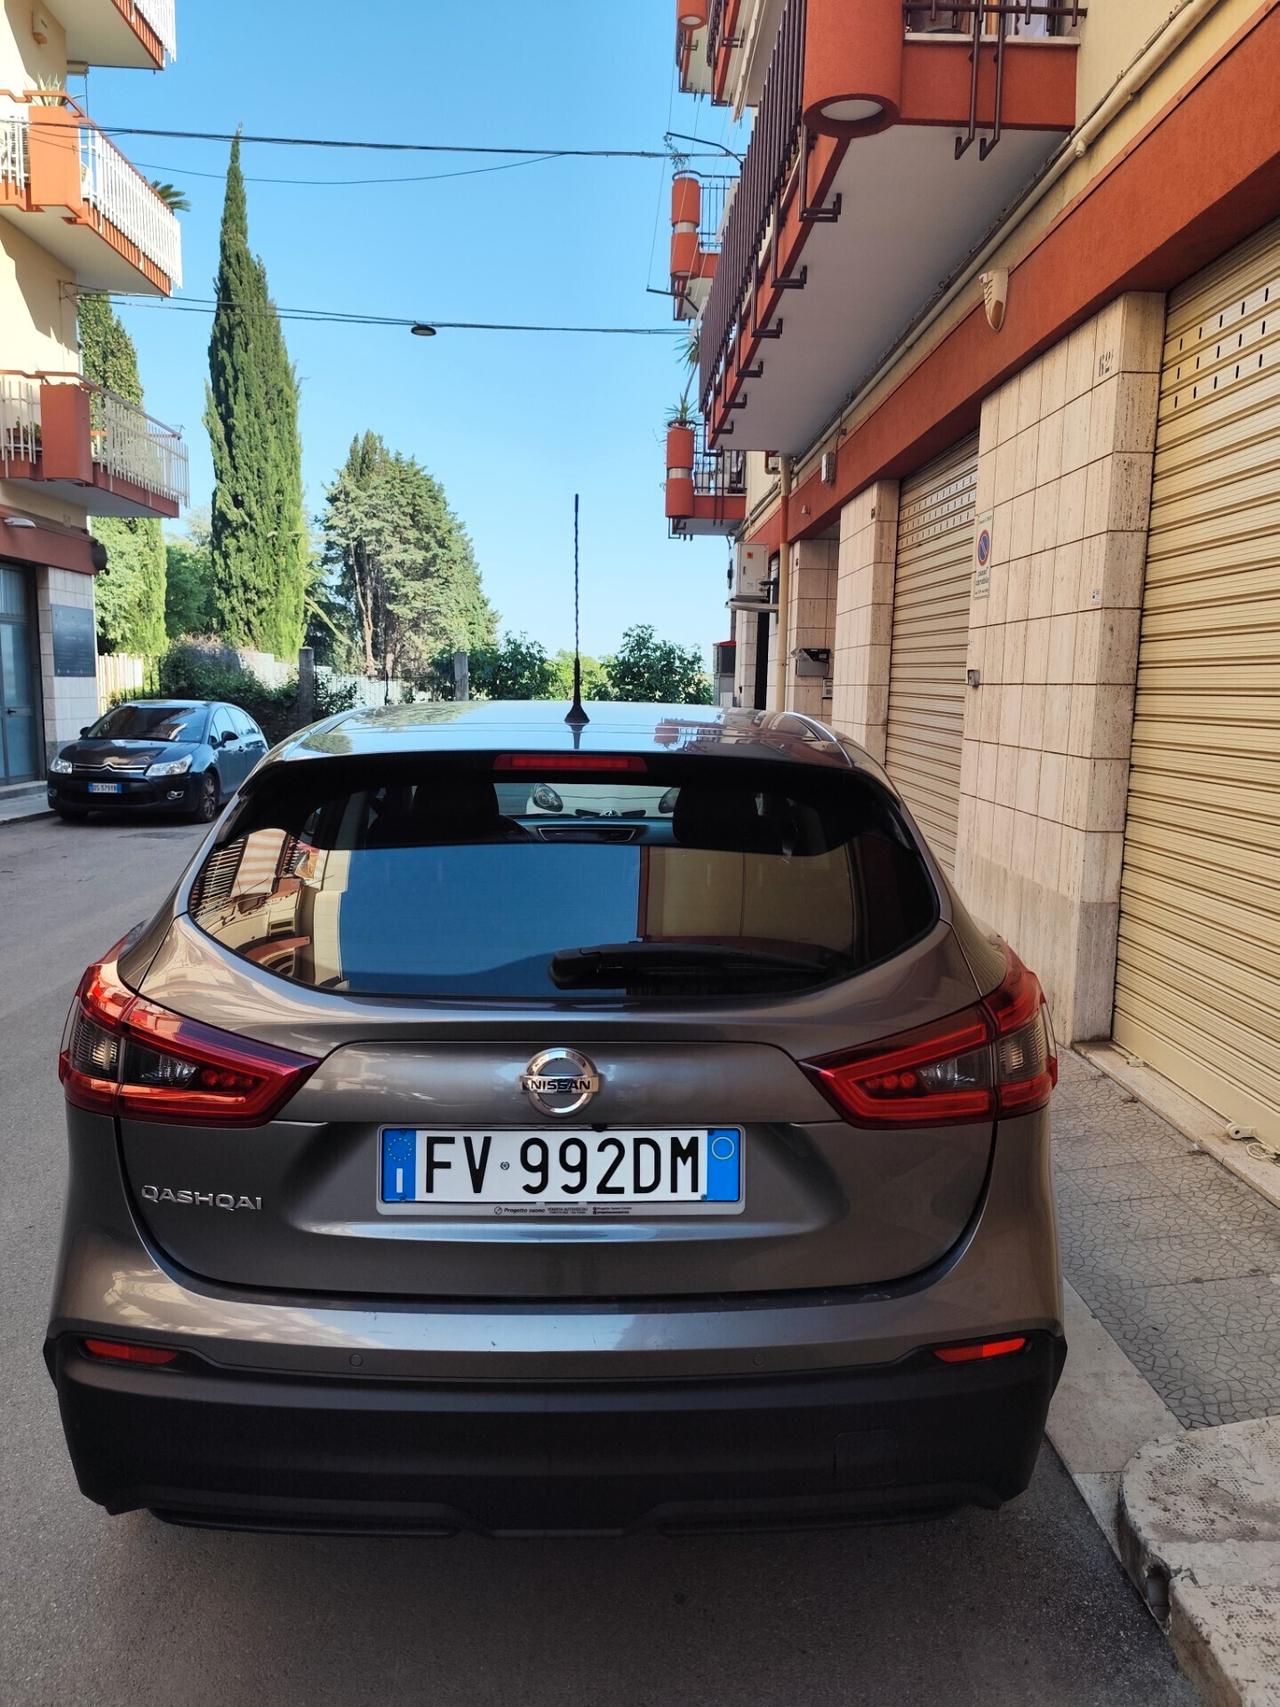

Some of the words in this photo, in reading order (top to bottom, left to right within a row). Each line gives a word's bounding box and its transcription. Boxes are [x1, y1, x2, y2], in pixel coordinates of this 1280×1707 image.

[530, 1080, 591, 1090] NISSAN
[425, 1136, 492, 1194] FV
[520, 1136, 700, 1195] 992DM
[395, 1167, 404, 1194] I
[141, 1185, 263, 1211] QASHQAI
